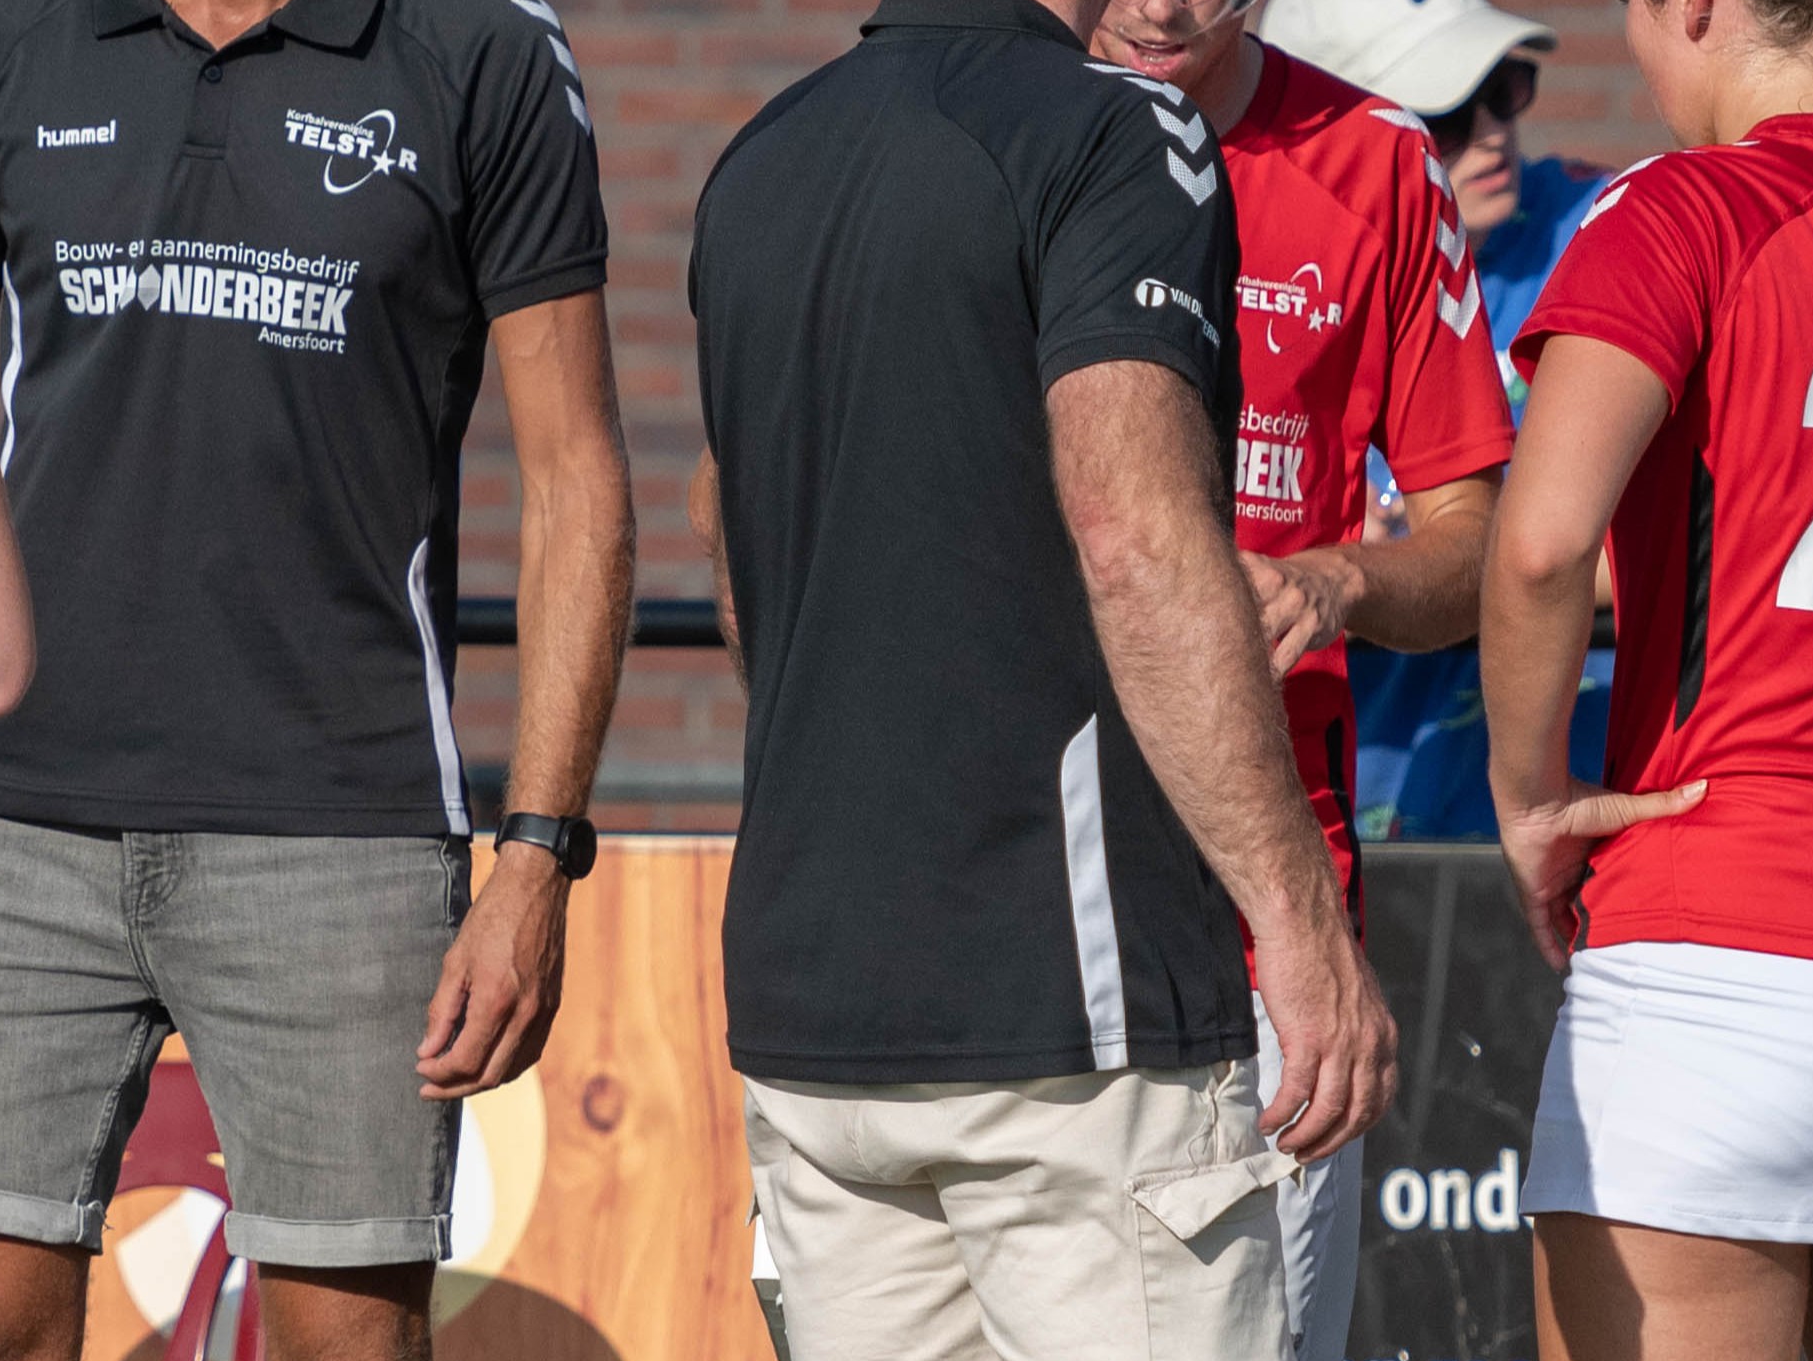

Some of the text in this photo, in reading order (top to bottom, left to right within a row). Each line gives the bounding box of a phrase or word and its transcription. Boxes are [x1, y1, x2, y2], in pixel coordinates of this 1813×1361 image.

[37, 120, 116, 148] hummel
[55, 240, 123, 262] Bouw-
[150, 239, 360, 286] aannemingsbedrijf
[1170, 288, 1192, 310] VAN
[258, 326, 346, 354] Amersfoort
